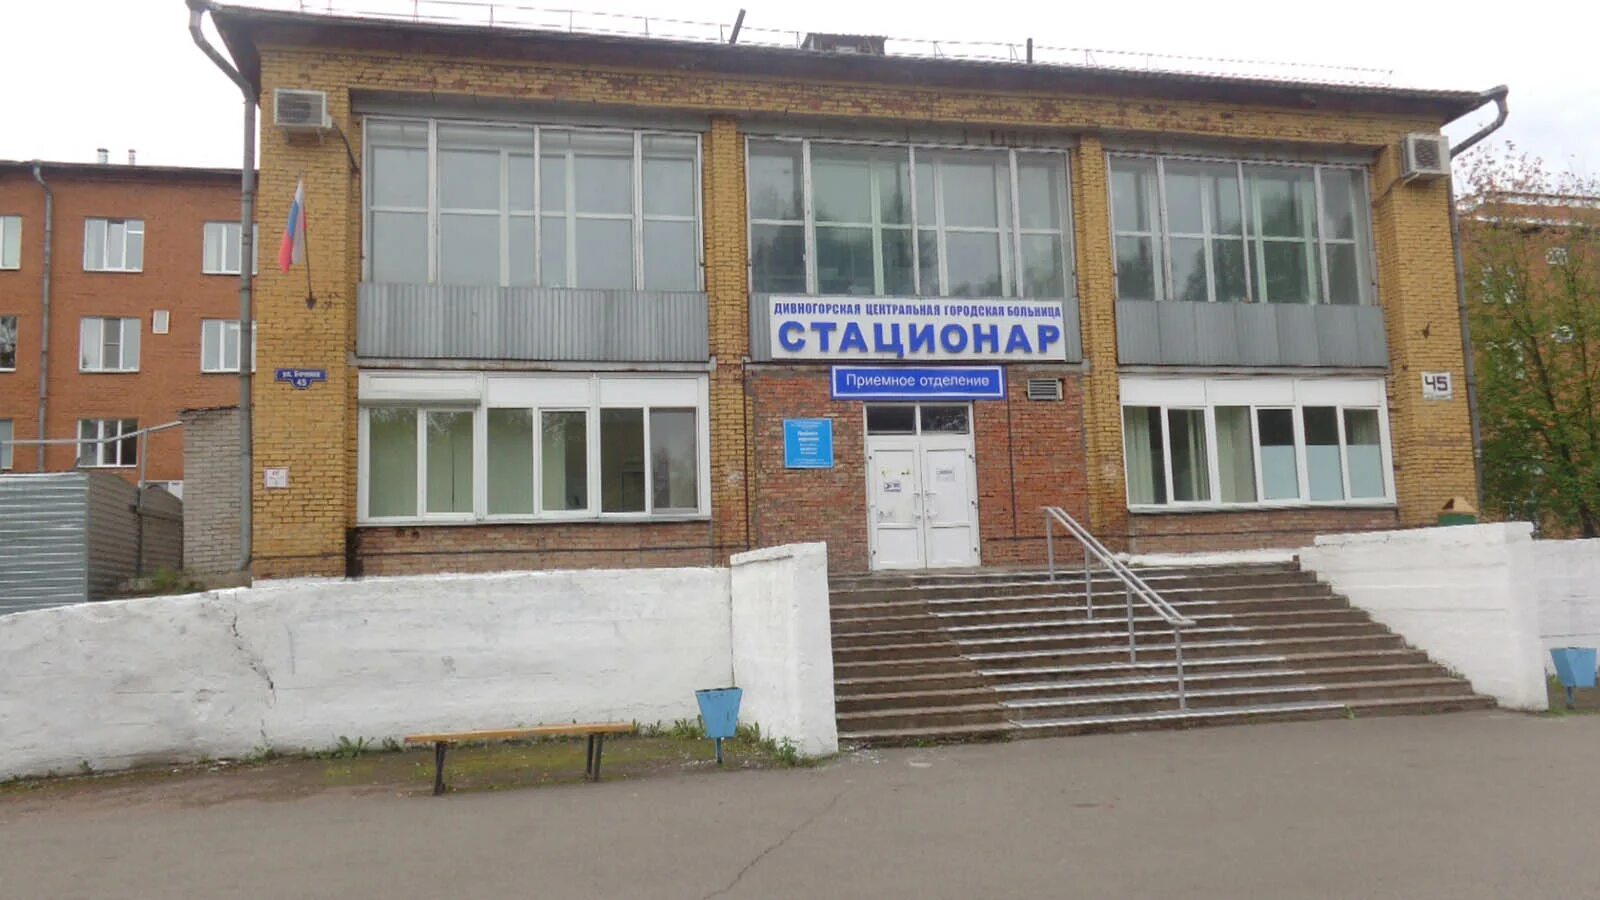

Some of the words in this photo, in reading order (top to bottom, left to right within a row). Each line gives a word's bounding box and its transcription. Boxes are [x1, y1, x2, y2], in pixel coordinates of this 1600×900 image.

[774, 303, 861, 314] ДИВНОГОРСКАЯ
[866, 303, 940, 316] ЦЕНТРАЛЬНАЯ
[944, 305, 1005, 317] ГОРОДСКАЯ
[1007, 307, 1062, 318] БОЛЬНИЦА
[778, 321, 1060, 358] СТАЦИОНАР
[846, 374, 915, 387] Приемное
[920, 376, 990, 387] отделение
[1424, 376, 1449, 392] 45
